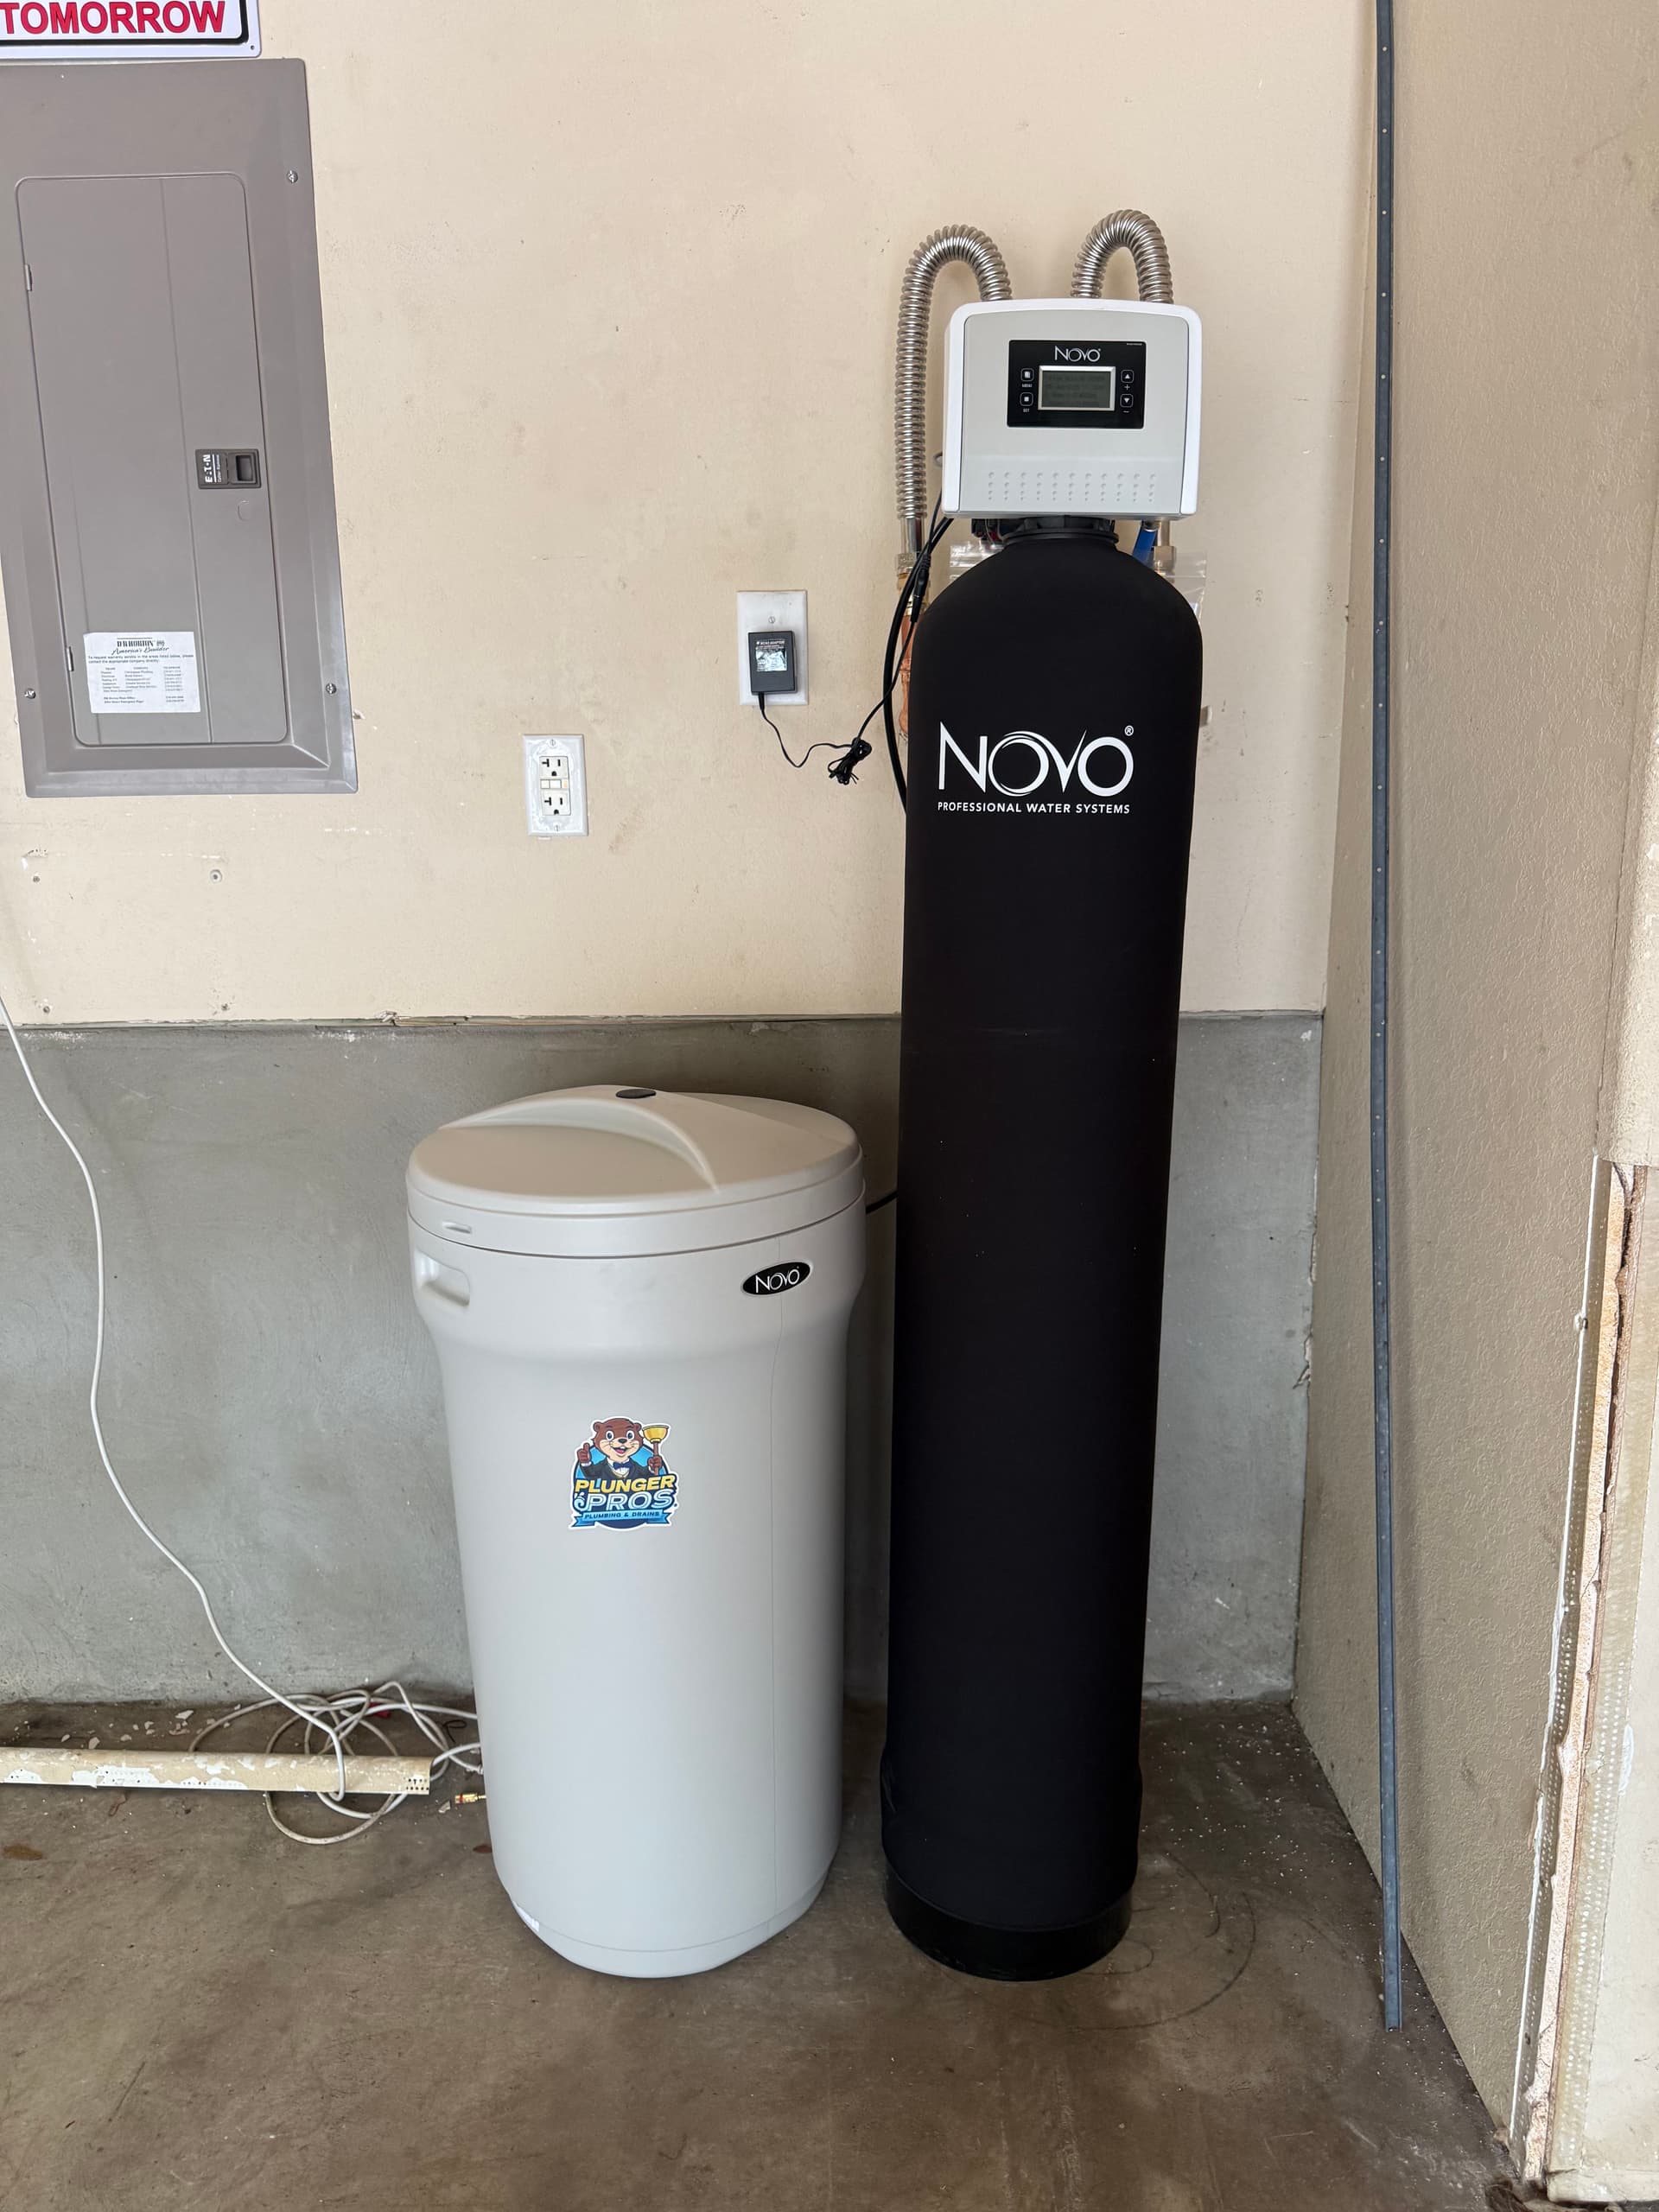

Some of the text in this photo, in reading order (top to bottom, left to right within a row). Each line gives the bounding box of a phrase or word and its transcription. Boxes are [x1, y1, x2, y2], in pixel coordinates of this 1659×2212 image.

[0, 1, 225, 34] TOMORROW
[1054, 346, 1101, 362] NOVO
[938, 721, 1134, 797] NOVO
[938, 801, 1130, 815] PROFESSIONAL WATER SYSTEMS
[755, 1268, 799, 1294] NOVO
[575, 1475, 675, 1493] PLUNGER
[588, 1489, 674, 1511] PROS
